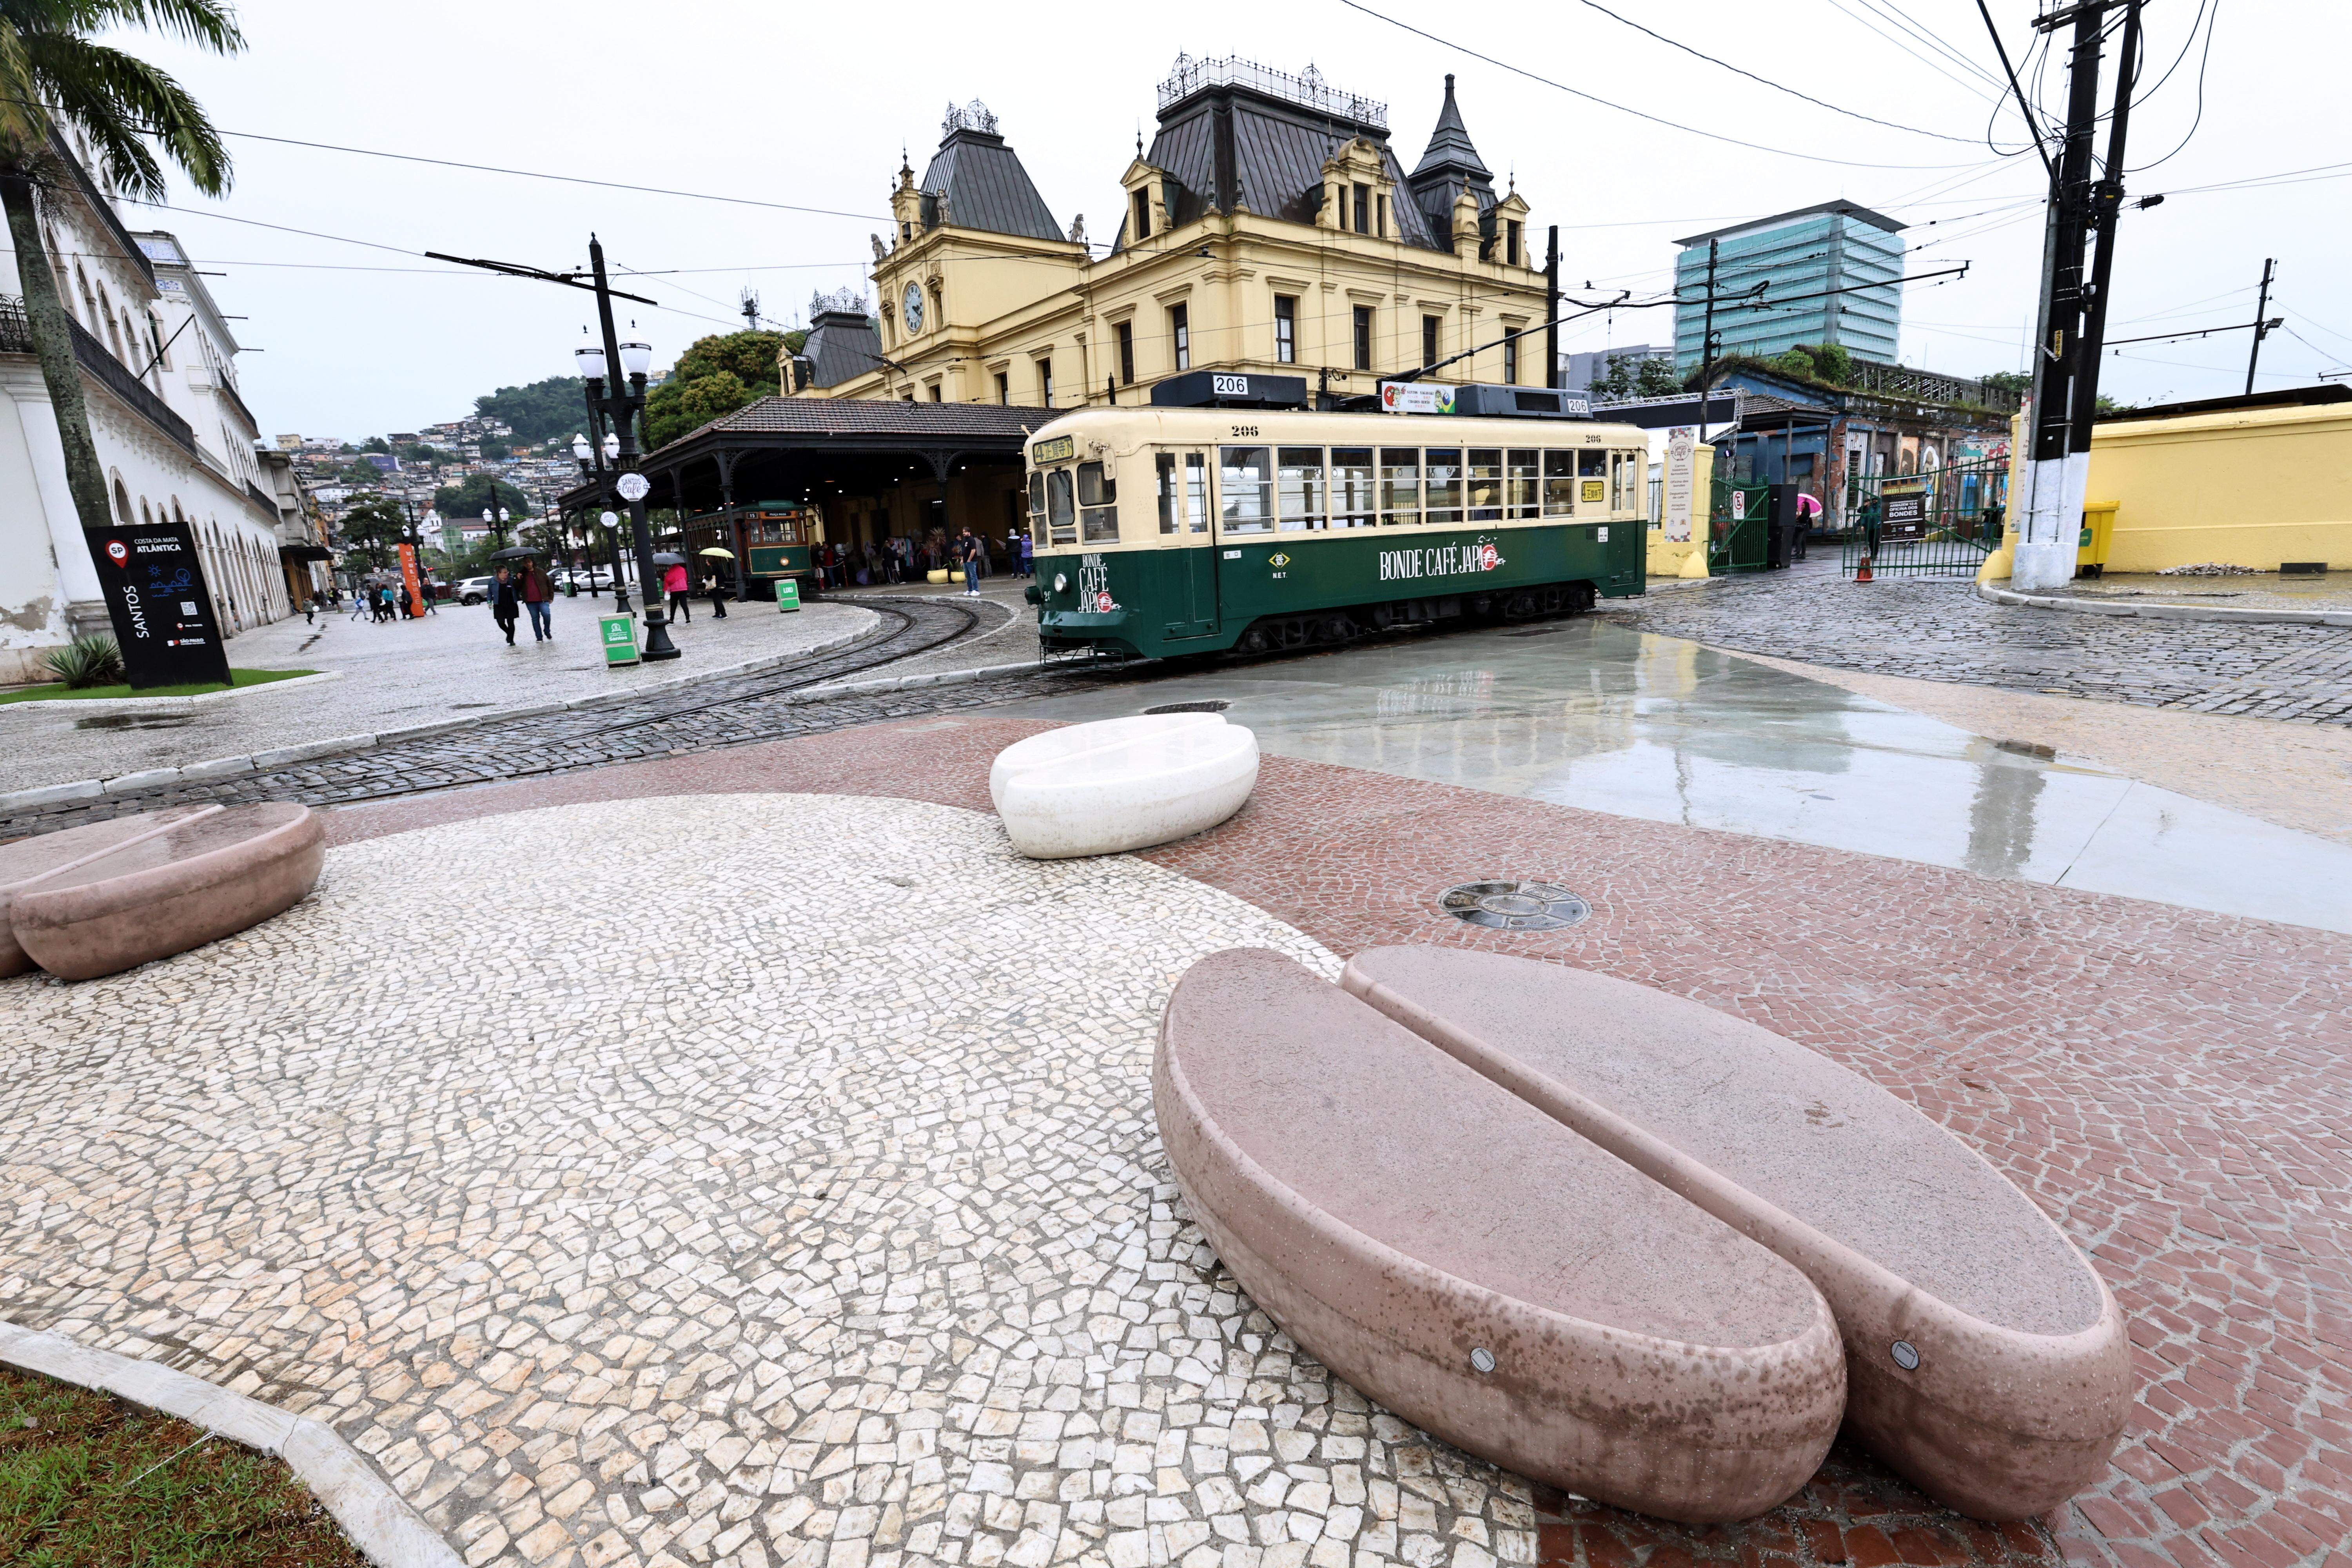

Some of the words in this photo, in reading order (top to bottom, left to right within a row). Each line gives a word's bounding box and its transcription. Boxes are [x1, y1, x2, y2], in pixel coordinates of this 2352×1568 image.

[1216, 377, 1245, 392] 206
[1570, 401, 1586, 411] 206
[1232, 426, 1259, 437] 206
[1586, 435, 1601, 443] 206
[622, 483, 641, 494] Café
[137, 544, 181, 553] ATLÂNTICA
[1082, 554, 1102, 568] BONDE
[1379, 549, 1423, 580] BONDE
[1426, 541, 1457, 576] CAFÉ
[1079, 563, 1109, 592] CAFÉ
[123, 586, 149, 638] SANTOS
